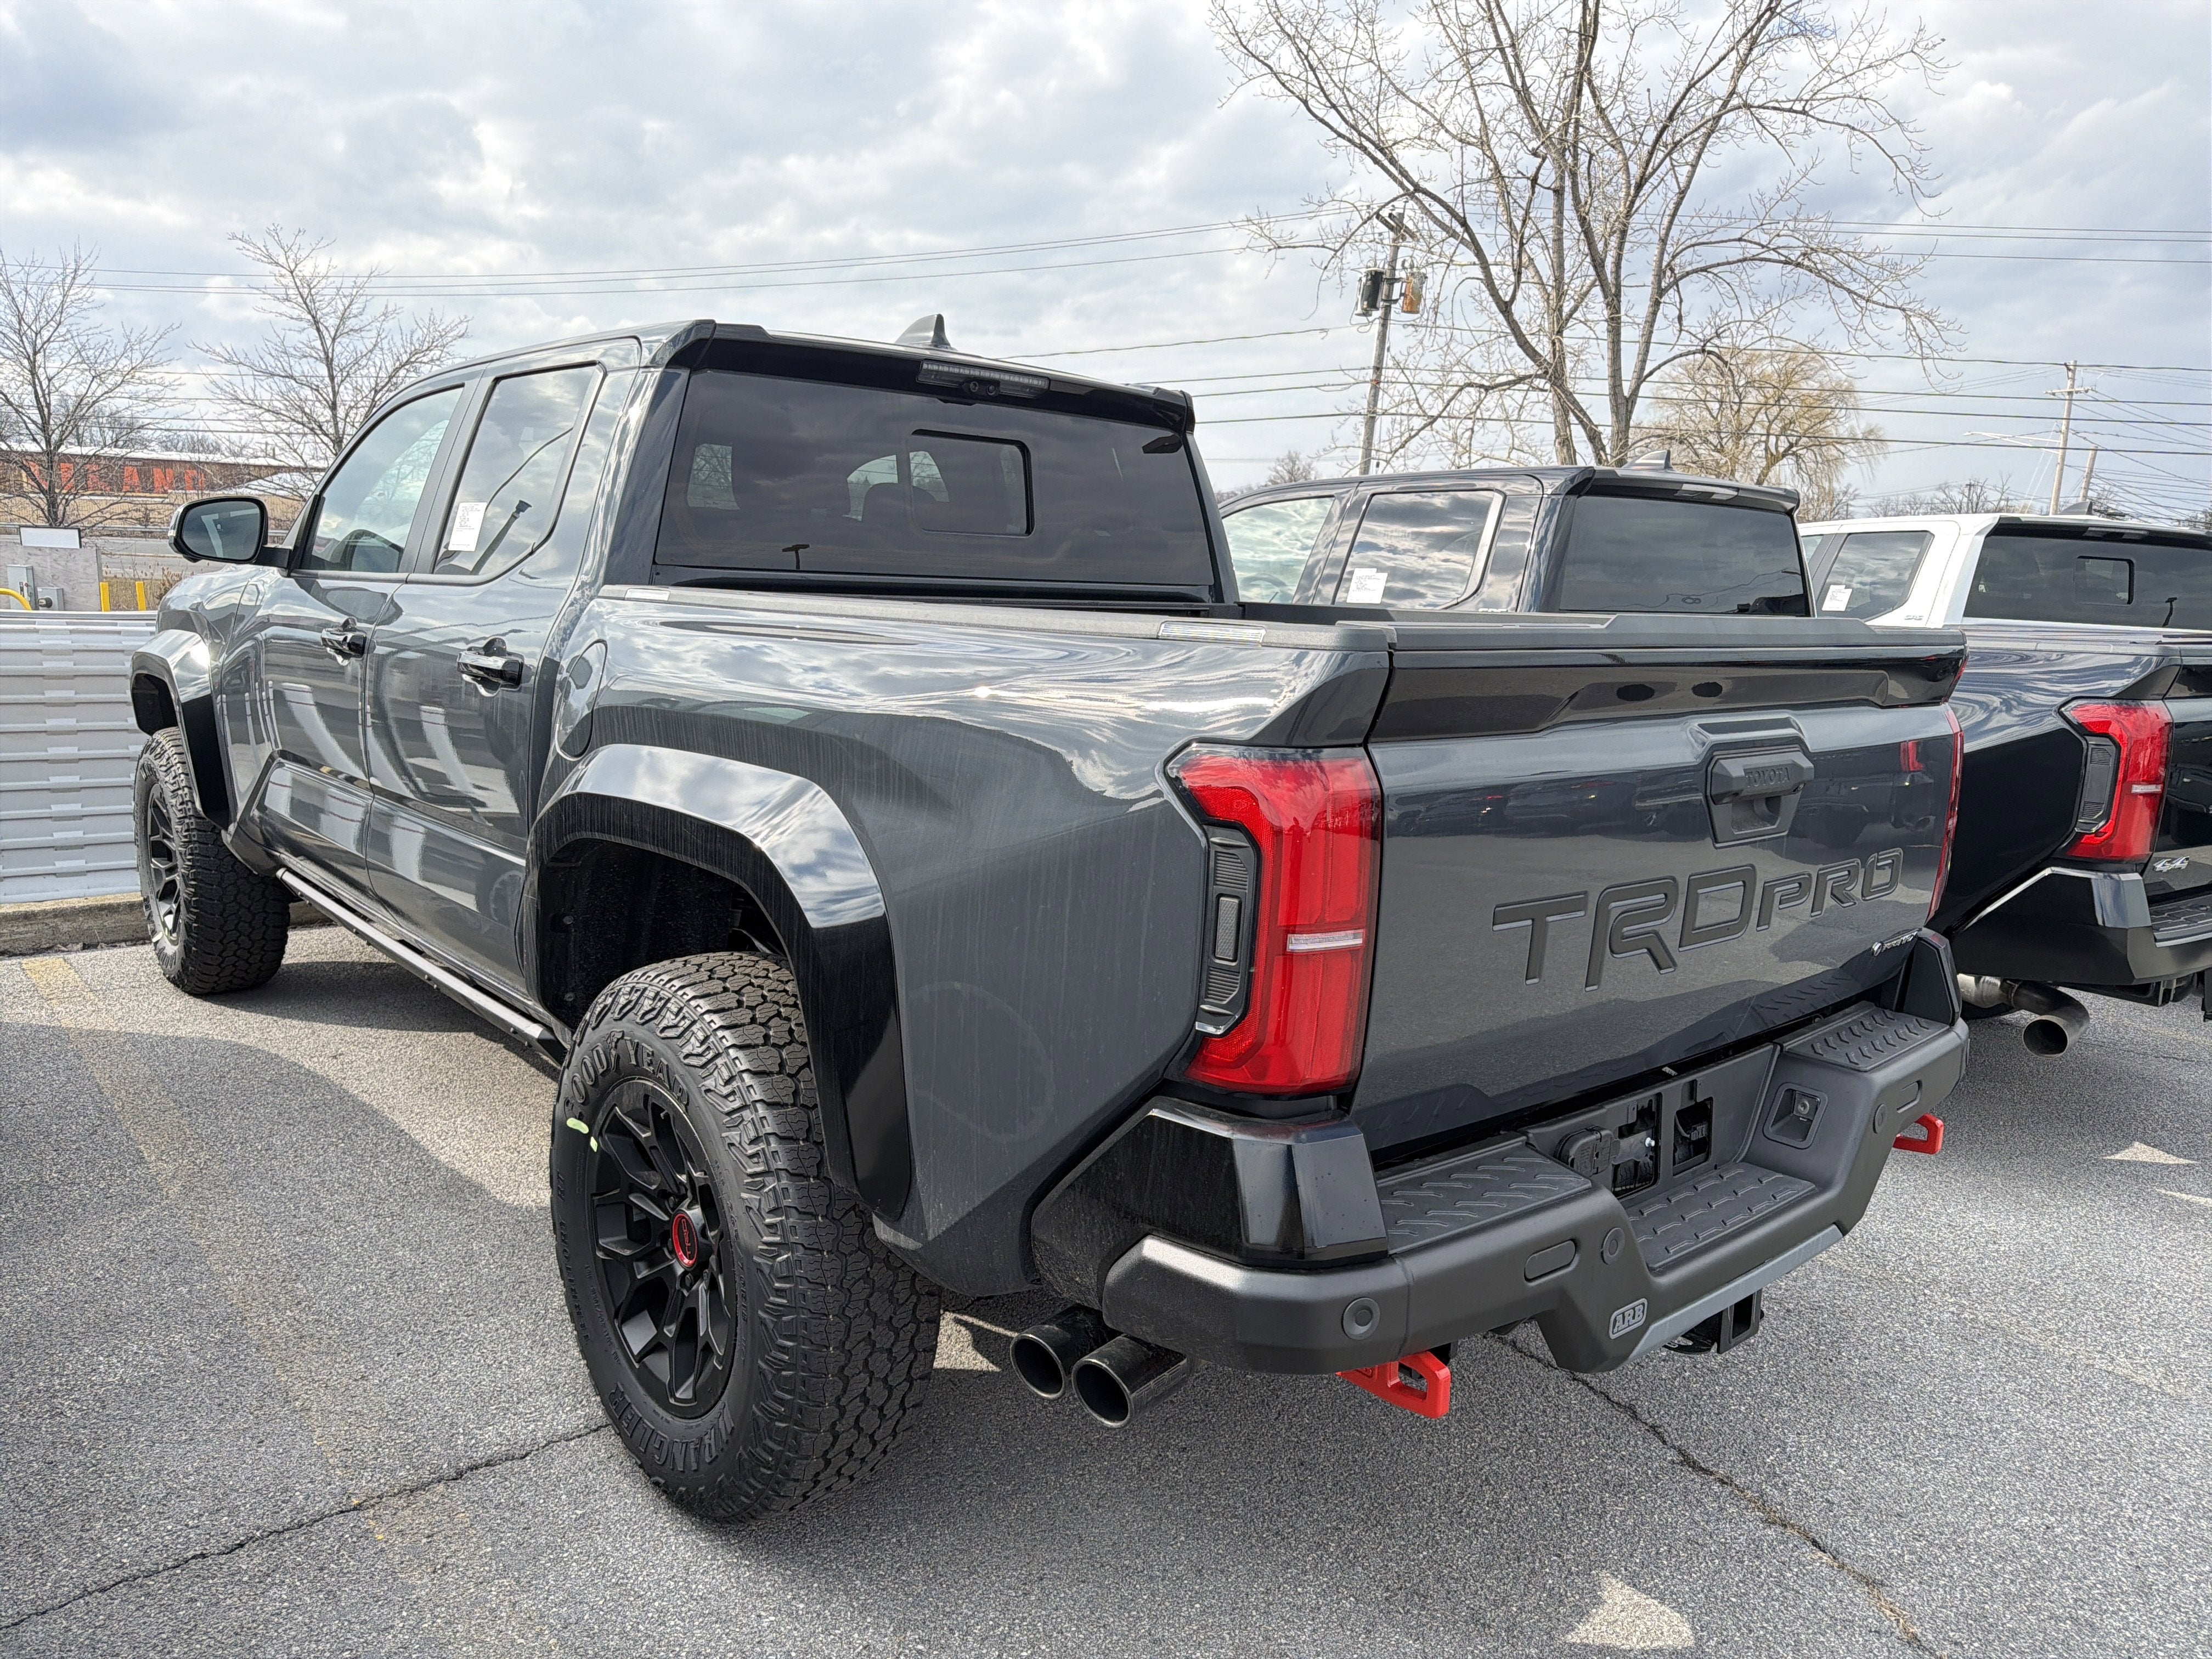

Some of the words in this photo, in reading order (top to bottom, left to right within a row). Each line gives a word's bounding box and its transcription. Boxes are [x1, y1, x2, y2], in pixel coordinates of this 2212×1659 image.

[1746, 768, 1790, 788] TOYOTA
[1492, 864, 1756, 992] TRD
[1756, 848, 1904, 932] PRO
[564, 1029, 690, 1120] GOODYEAR
[1613, 1305, 1644, 1334] ARB
[609, 1381, 734, 1472] WRANGLER
